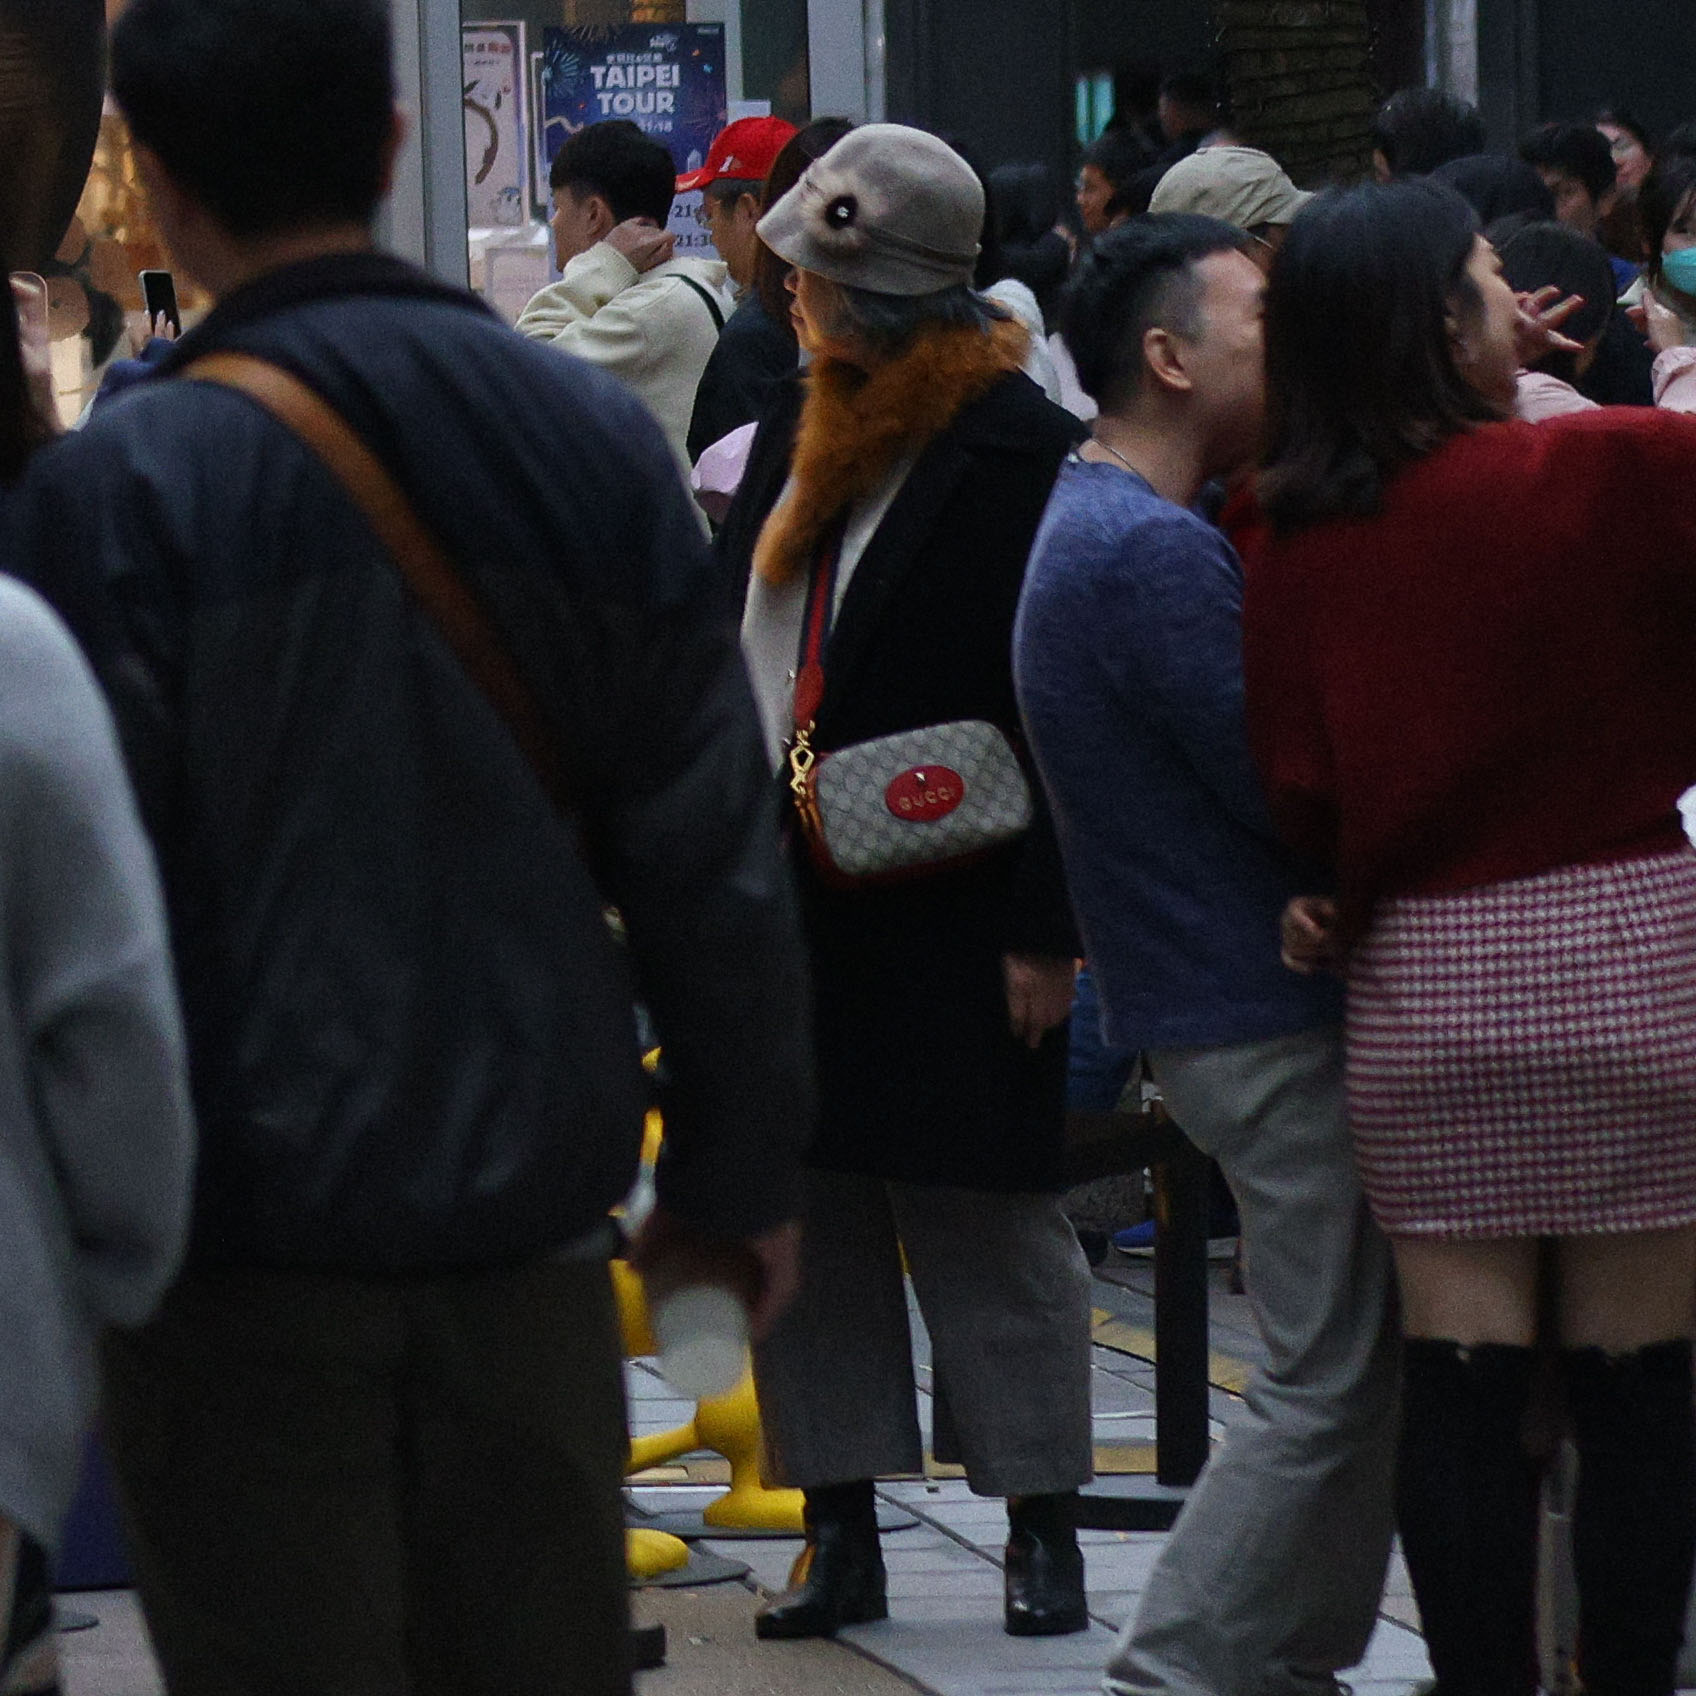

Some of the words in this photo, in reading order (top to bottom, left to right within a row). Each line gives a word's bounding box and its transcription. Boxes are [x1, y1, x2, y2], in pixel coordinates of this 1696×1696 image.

[590, 64, 681, 89] TAIPEI
[597, 91, 675, 115] TOUR
[899, 787, 956, 811] GUCCI
